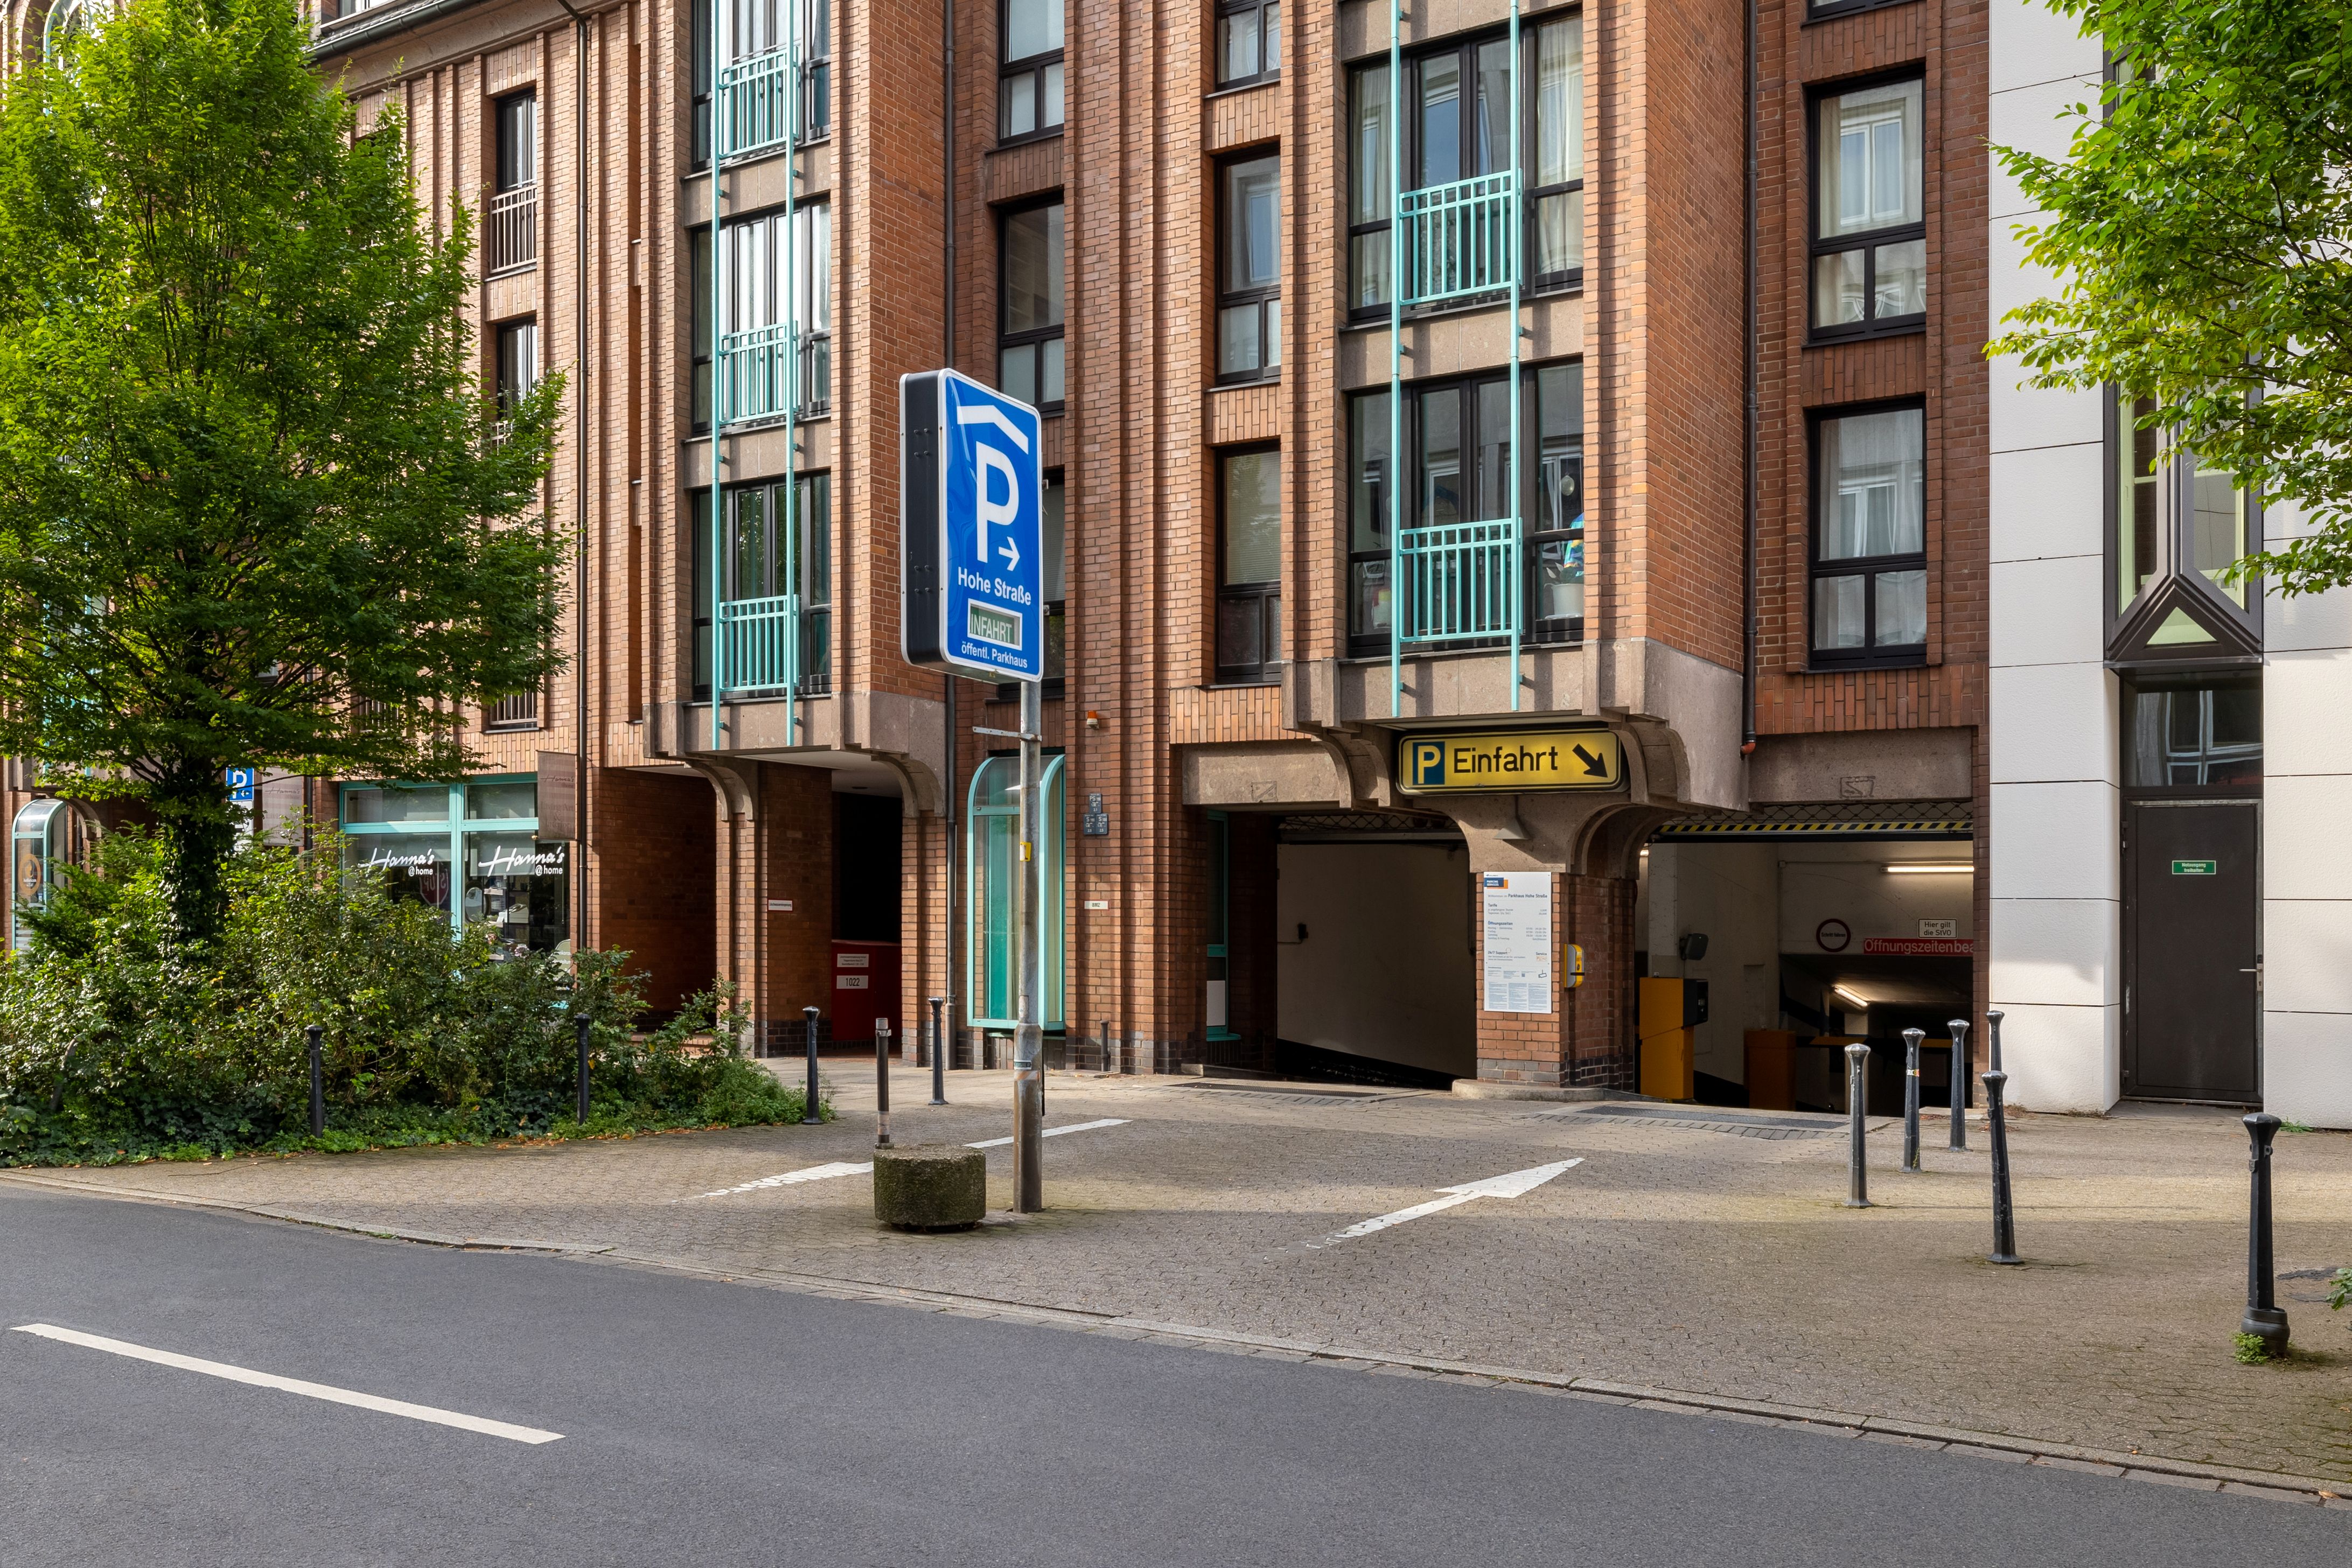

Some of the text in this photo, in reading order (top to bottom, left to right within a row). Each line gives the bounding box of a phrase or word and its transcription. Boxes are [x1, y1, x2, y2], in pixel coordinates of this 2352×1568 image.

[975, 440, 1019, 563] P
[958, 566, 1031, 606] Hohe Straße
[970, 613, 1012, 643] INFAHRT
[961, 641, 1028, 668] öffentl. Parkhaus
[1417, 745, 1558, 784] P Einfahrt
[540, 774, 574, 783] Hanna's
[357, 848, 435, 877] Hanna's
[408, 866, 433, 877] @home
[478, 845, 565, 877] Hanna's
[535, 865, 563, 877] @home
[1940, 921, 1951, 929] gilt
[1864, 939, 1953, 954] Öffnungszeiten
[846, 977, 860, 986] 1022
